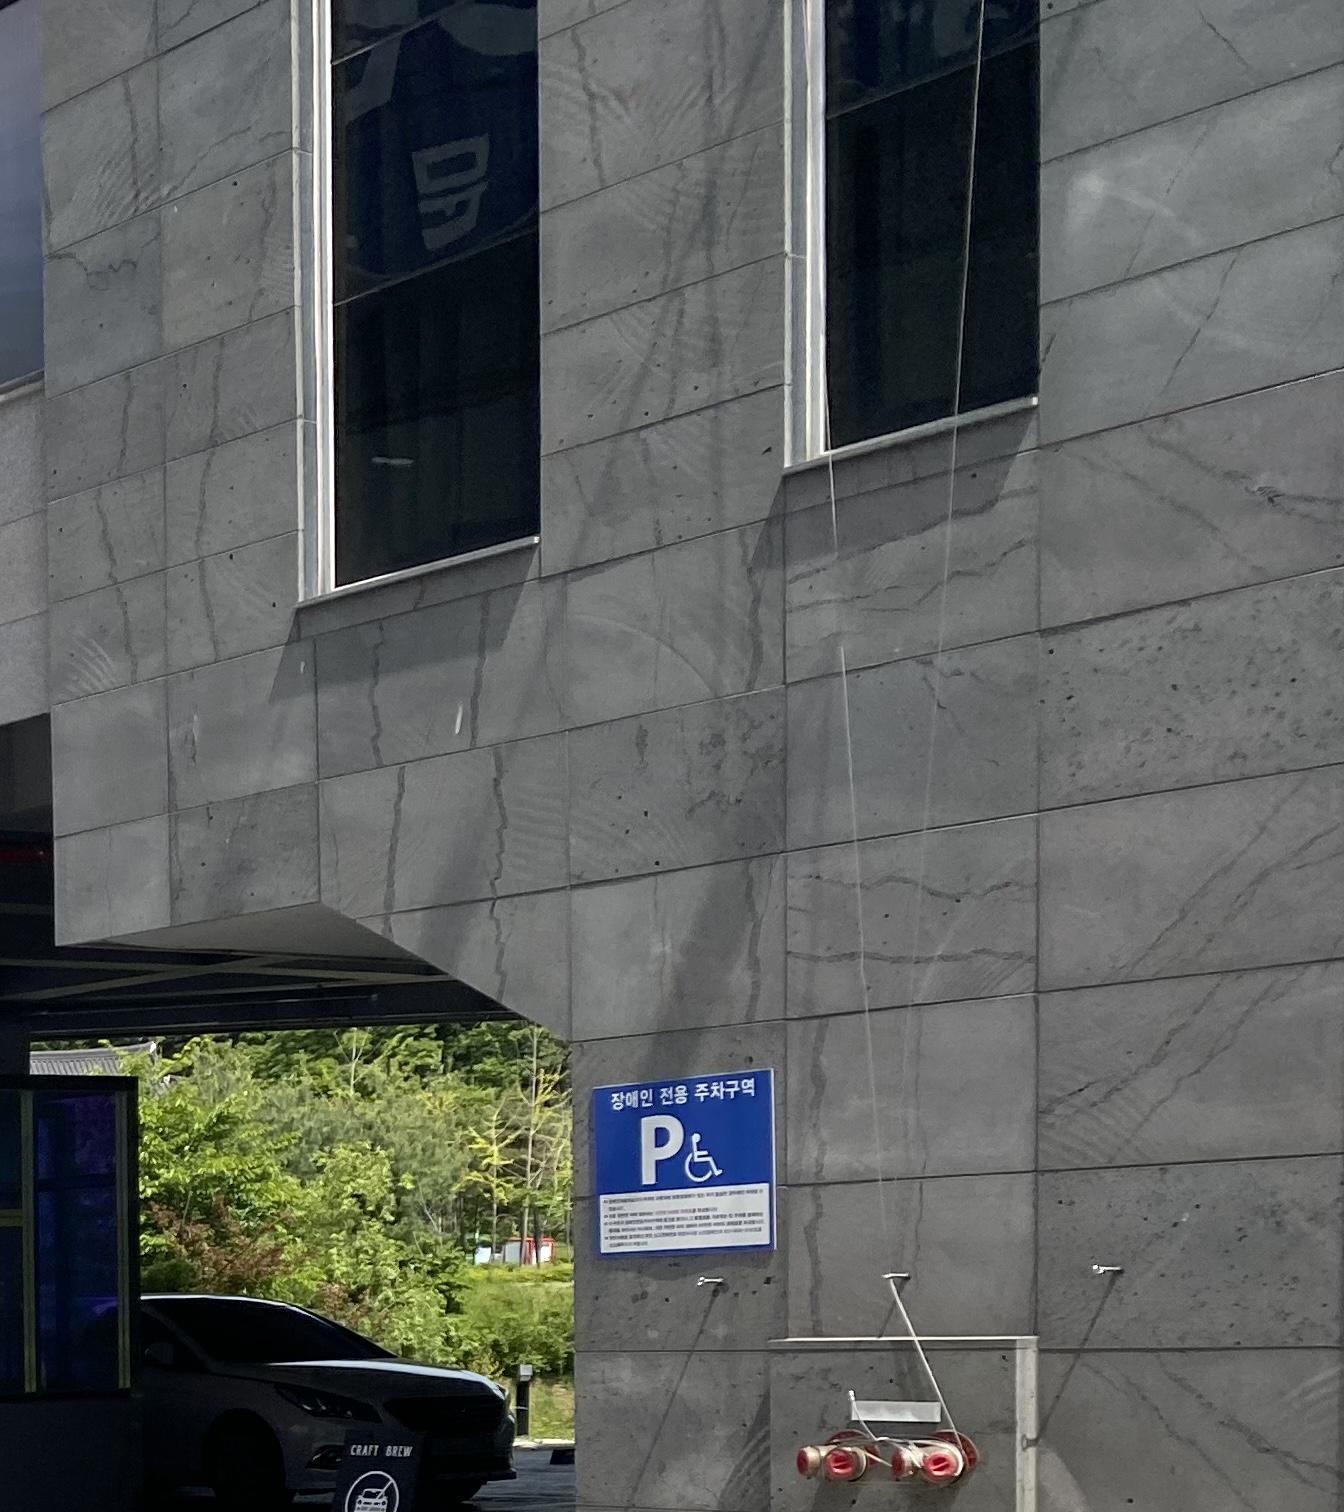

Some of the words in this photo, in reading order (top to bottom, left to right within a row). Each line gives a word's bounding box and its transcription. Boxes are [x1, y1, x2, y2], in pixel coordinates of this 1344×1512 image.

[611, 1088, 654, 1111] 장애인
[659, 1085, 689, 1106] 전용
[694, 1077, 755, 1102] 주차구역
[640, 1114, 685, 1185] P
[350, 1444, 379, 1457] CRAFT
[385, 1445, 413, 1458] BREW
